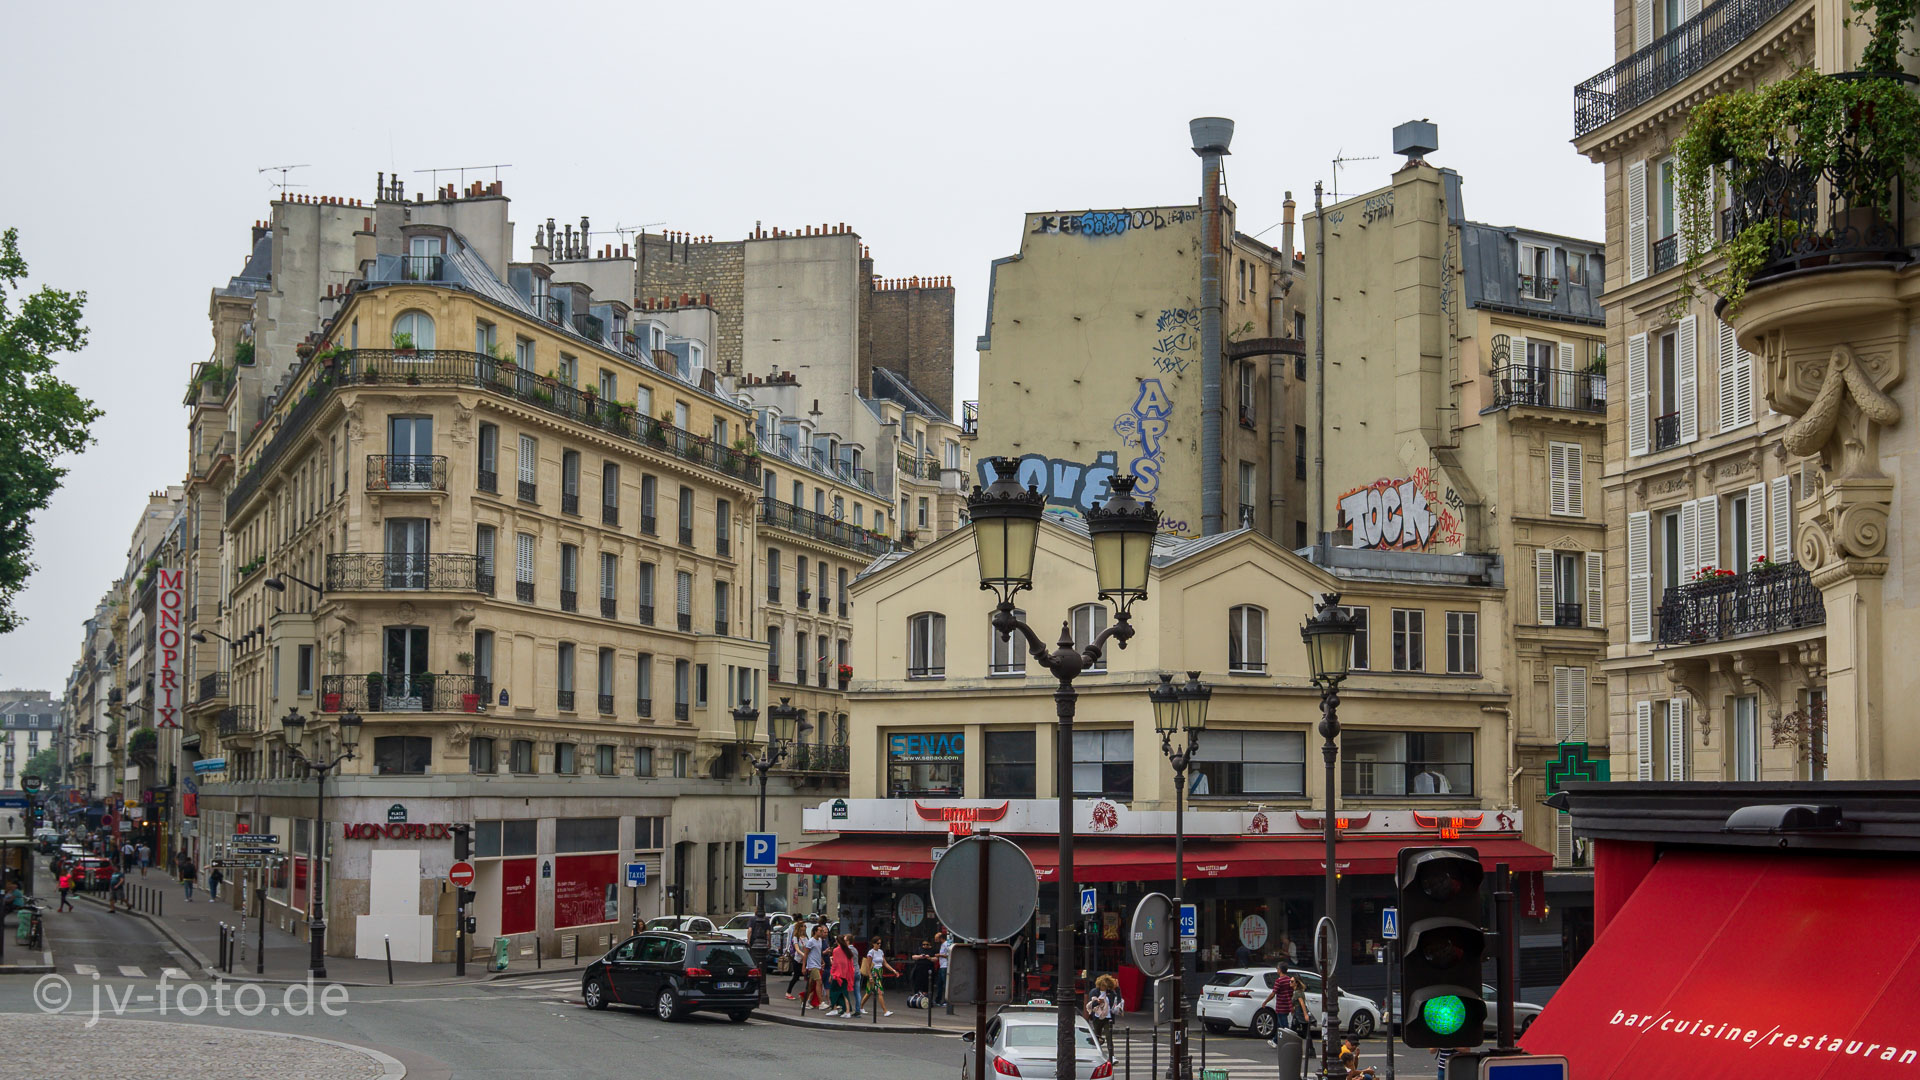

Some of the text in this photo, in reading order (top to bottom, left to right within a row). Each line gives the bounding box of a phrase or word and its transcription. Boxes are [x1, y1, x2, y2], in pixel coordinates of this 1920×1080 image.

[1337, 479, 1438, 550] TOCK
[158, 569, 184, 728] MONOPRIX
[344, 823, 453, 840] MONOPRIX
[753, 839, 769, 860] P
